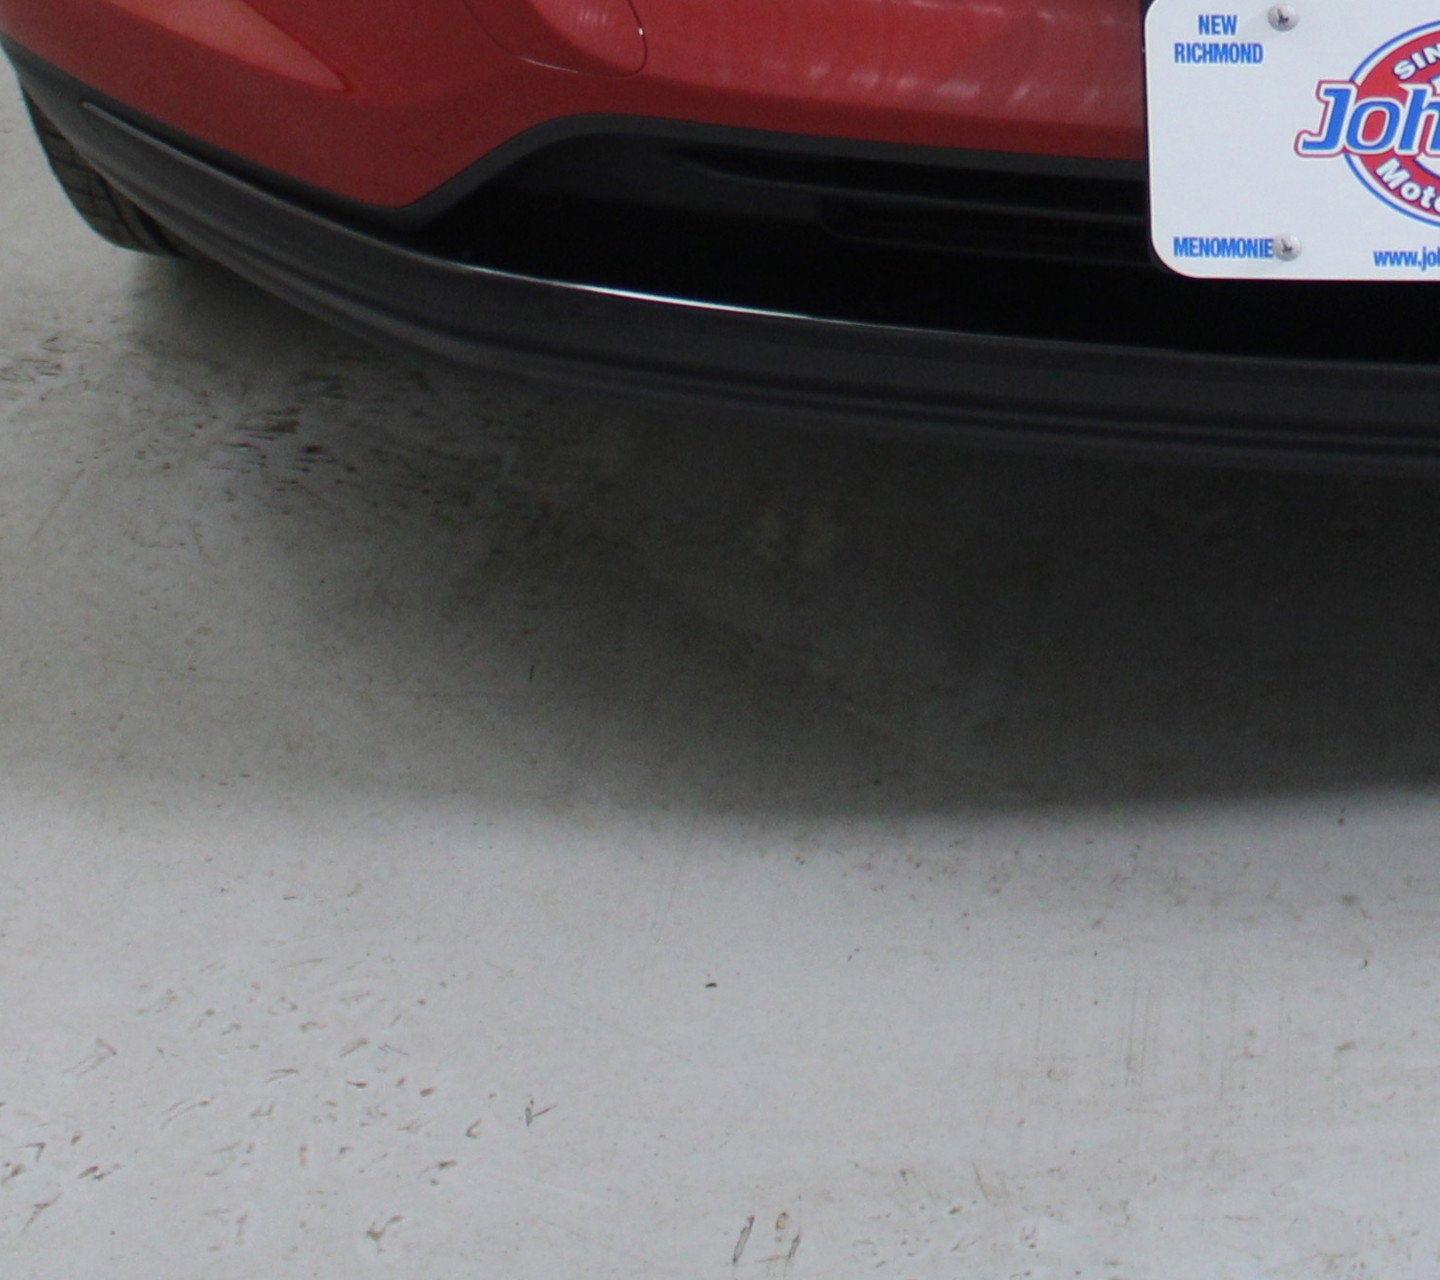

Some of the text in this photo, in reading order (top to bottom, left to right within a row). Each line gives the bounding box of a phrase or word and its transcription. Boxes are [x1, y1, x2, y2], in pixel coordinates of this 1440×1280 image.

[1197, 14, 1238, 37] NEW
[1173, 42, 1264, 64] RICHMOND
[1173, 237, 1274, 260] MENOMONIE
